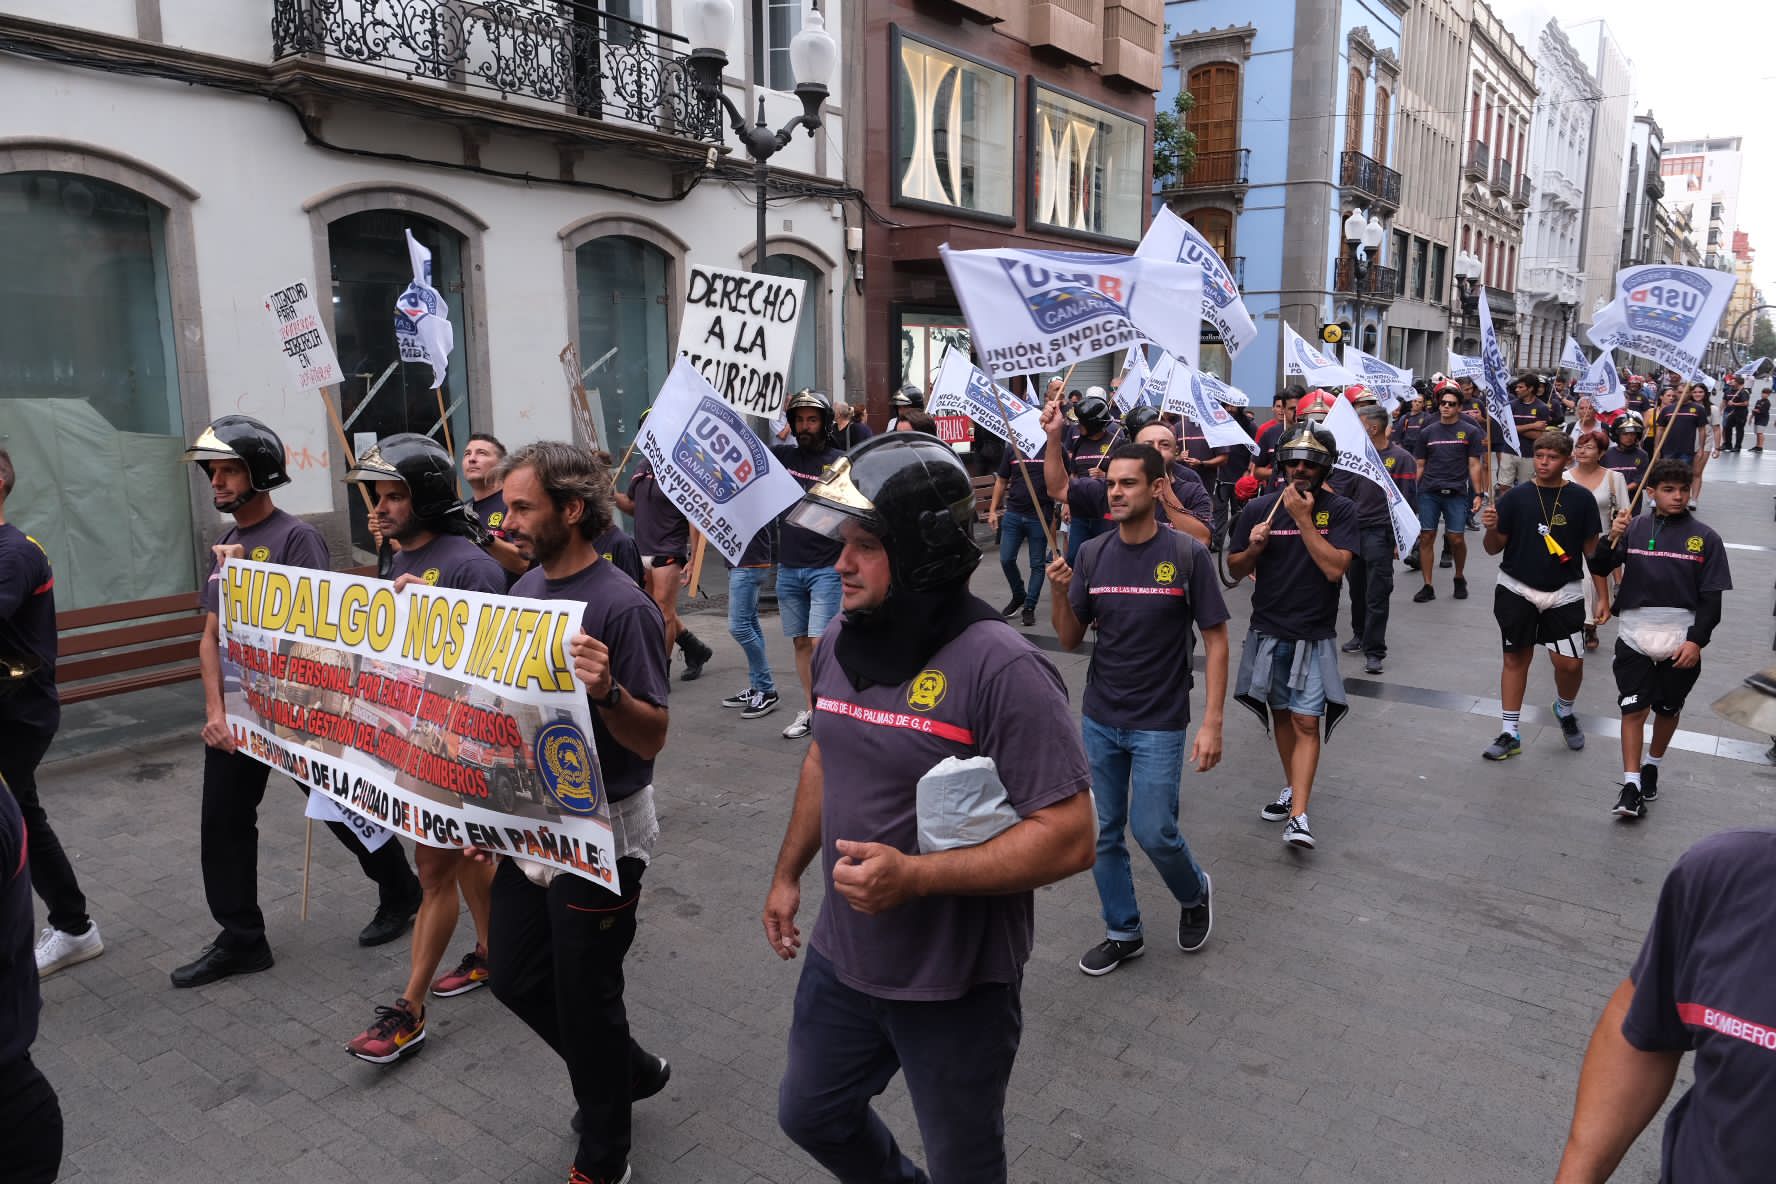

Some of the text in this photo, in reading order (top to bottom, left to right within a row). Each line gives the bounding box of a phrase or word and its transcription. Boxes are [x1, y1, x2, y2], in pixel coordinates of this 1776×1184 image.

[686, 269, 797, 323] DERECHO
[704, 315, 767, 361] A LA
[1071, 346, 1083, 358] Y
[938, 392, 961, 402] NIÓN
[679, 450, 725, 498] CANARIAS
[695, 416, 753, 484] USPB
[664, 464, 715, 519] SINDICAL
[715, 516, 733, 536] DE
[731, 533, 743, 552] LA
[667, 484, 678, 495] Y
[676, 494, 737, 558] BOMBEROS
[401, 593, 470, 670] NOS
[464, 604, 577, 693] MATA!
[271, 651, 288, 681] DE
[356, 671, 380, 701] POR
[454, 702, 523, 748] RECURSOS
[839, 703, 848, 715] DE
[849, 705, 863, 719] LAS
[863, 709, 895, 725] PALMAS
[896, 714, 911, 726] DE
[911, 718, 922, 730] G.
[922, 720, 932, 732] C.
[273, 698, 306, 732] MALA
[307, 708, 356, 745] GESTIÓN
[355, 722, 378, 754] DEL
[418, 752, 489, 800] BOMBEROS
[232, 723, 613, 885] LA SEGURIDAD DE LA CIUDAD DE LPGC EN PAÑALES
